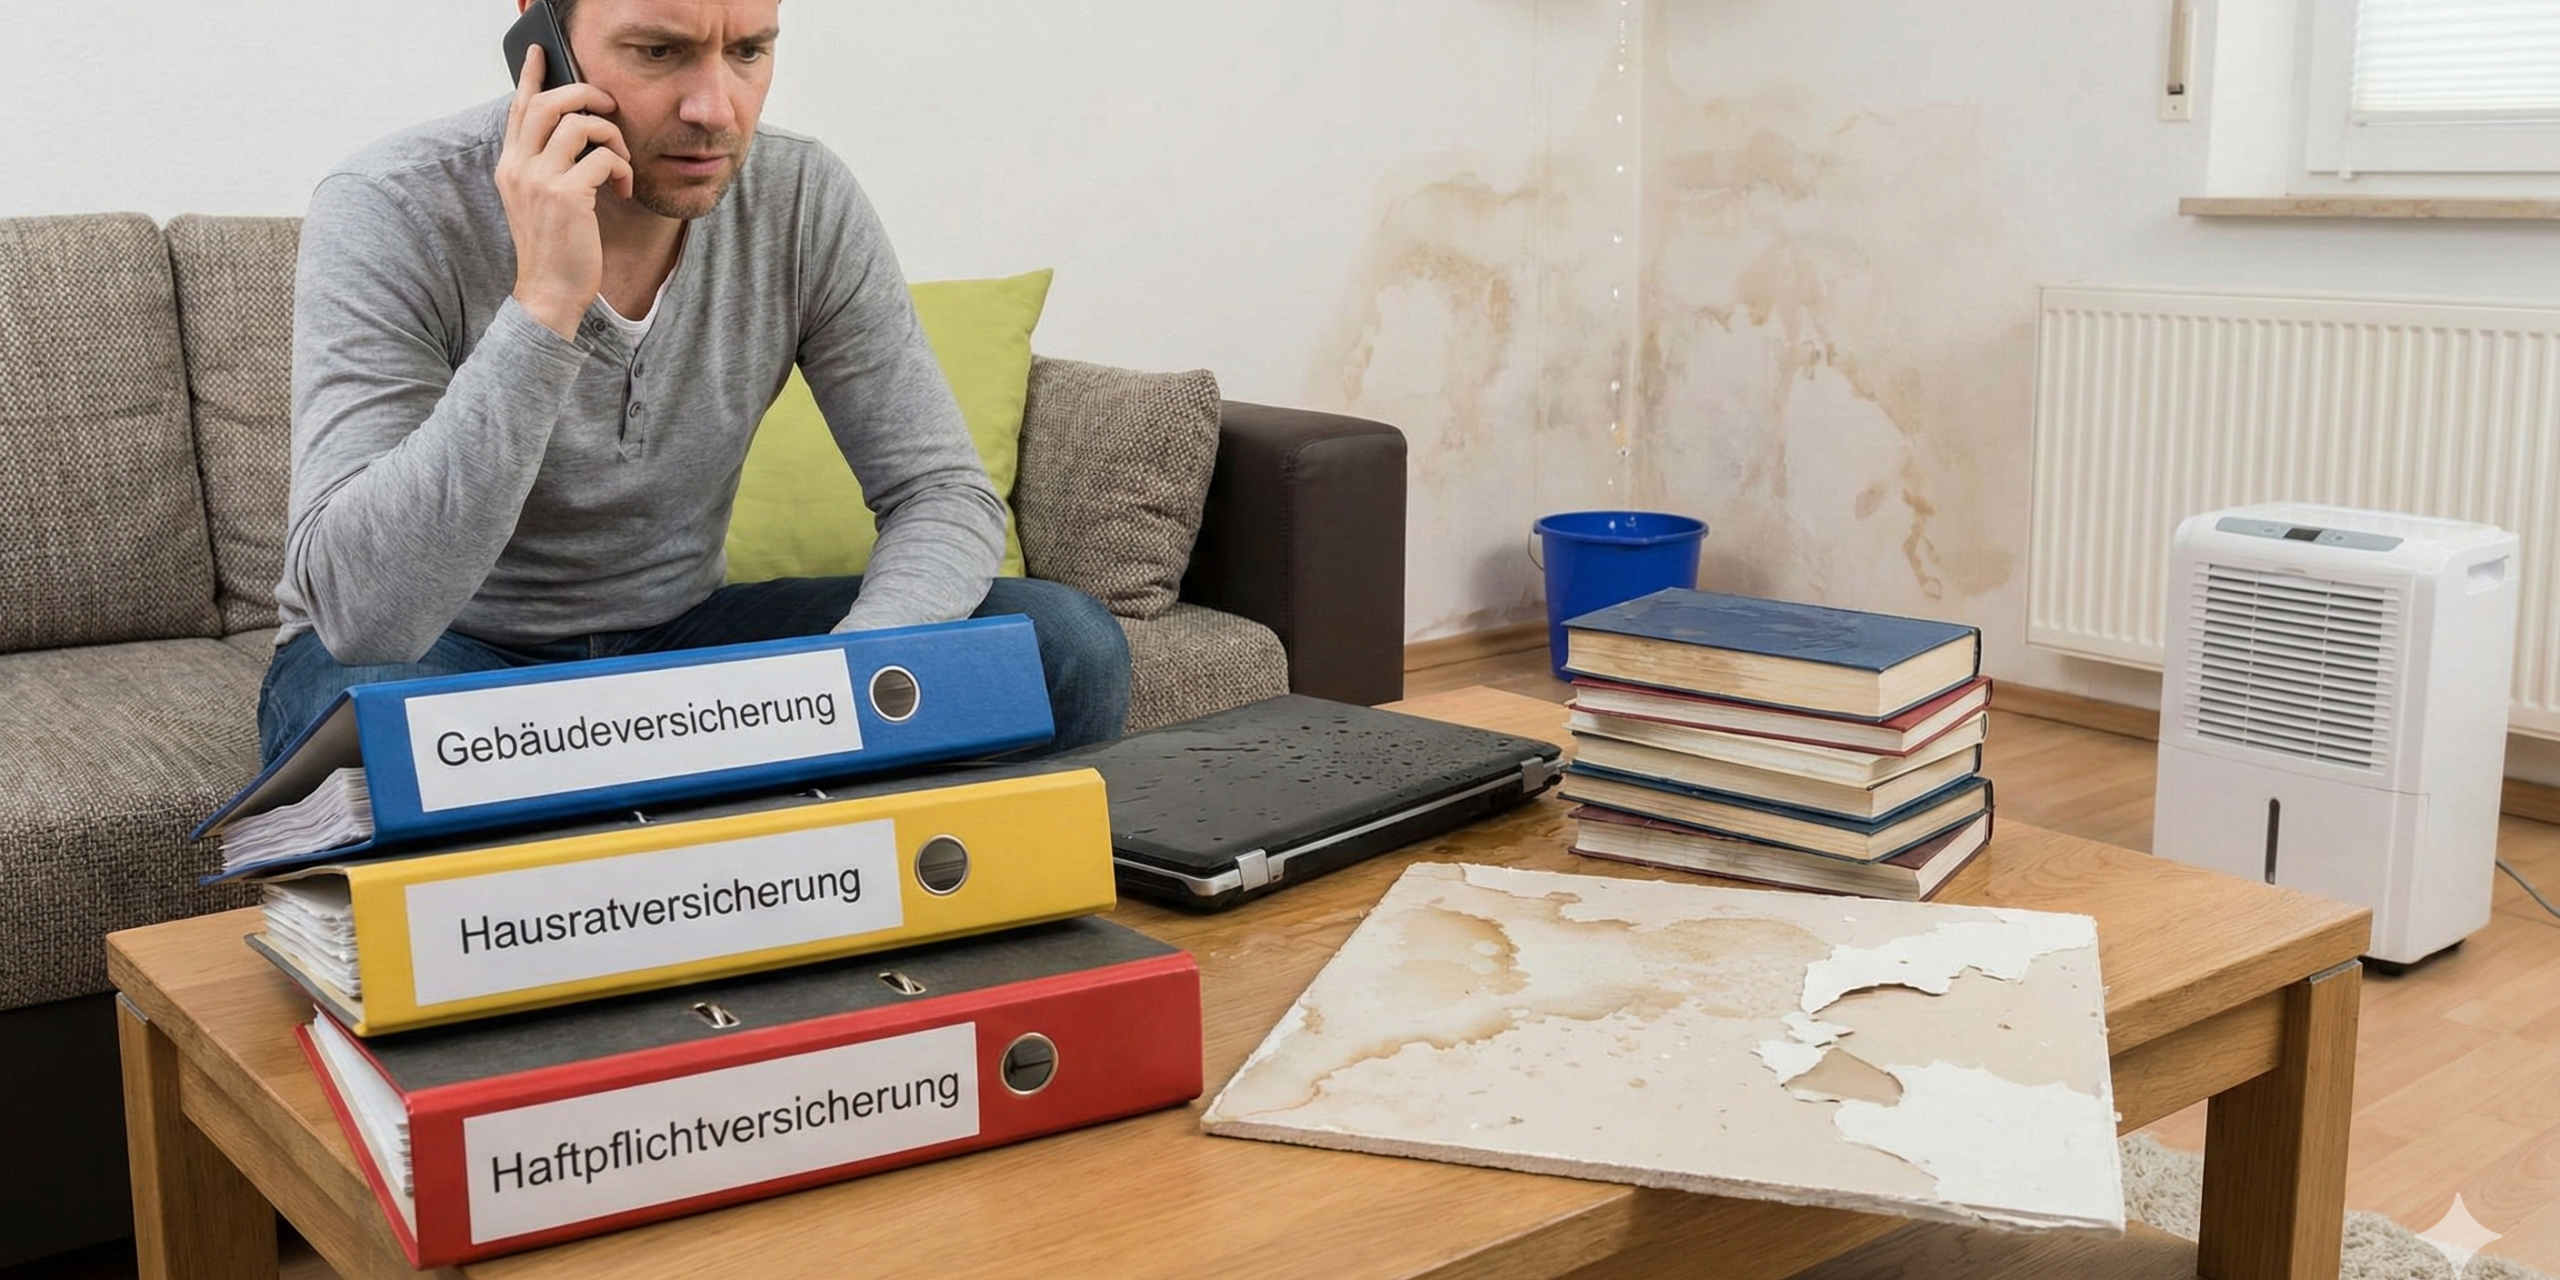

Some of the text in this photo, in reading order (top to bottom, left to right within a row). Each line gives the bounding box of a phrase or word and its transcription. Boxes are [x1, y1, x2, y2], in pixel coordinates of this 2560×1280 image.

[436, 692, 837, 768] Gebäudeversicherung
[459, 867, 862, 955] Hausratversicherung
[491, 1071, 960, 1195] Haftpflichtversicherung
